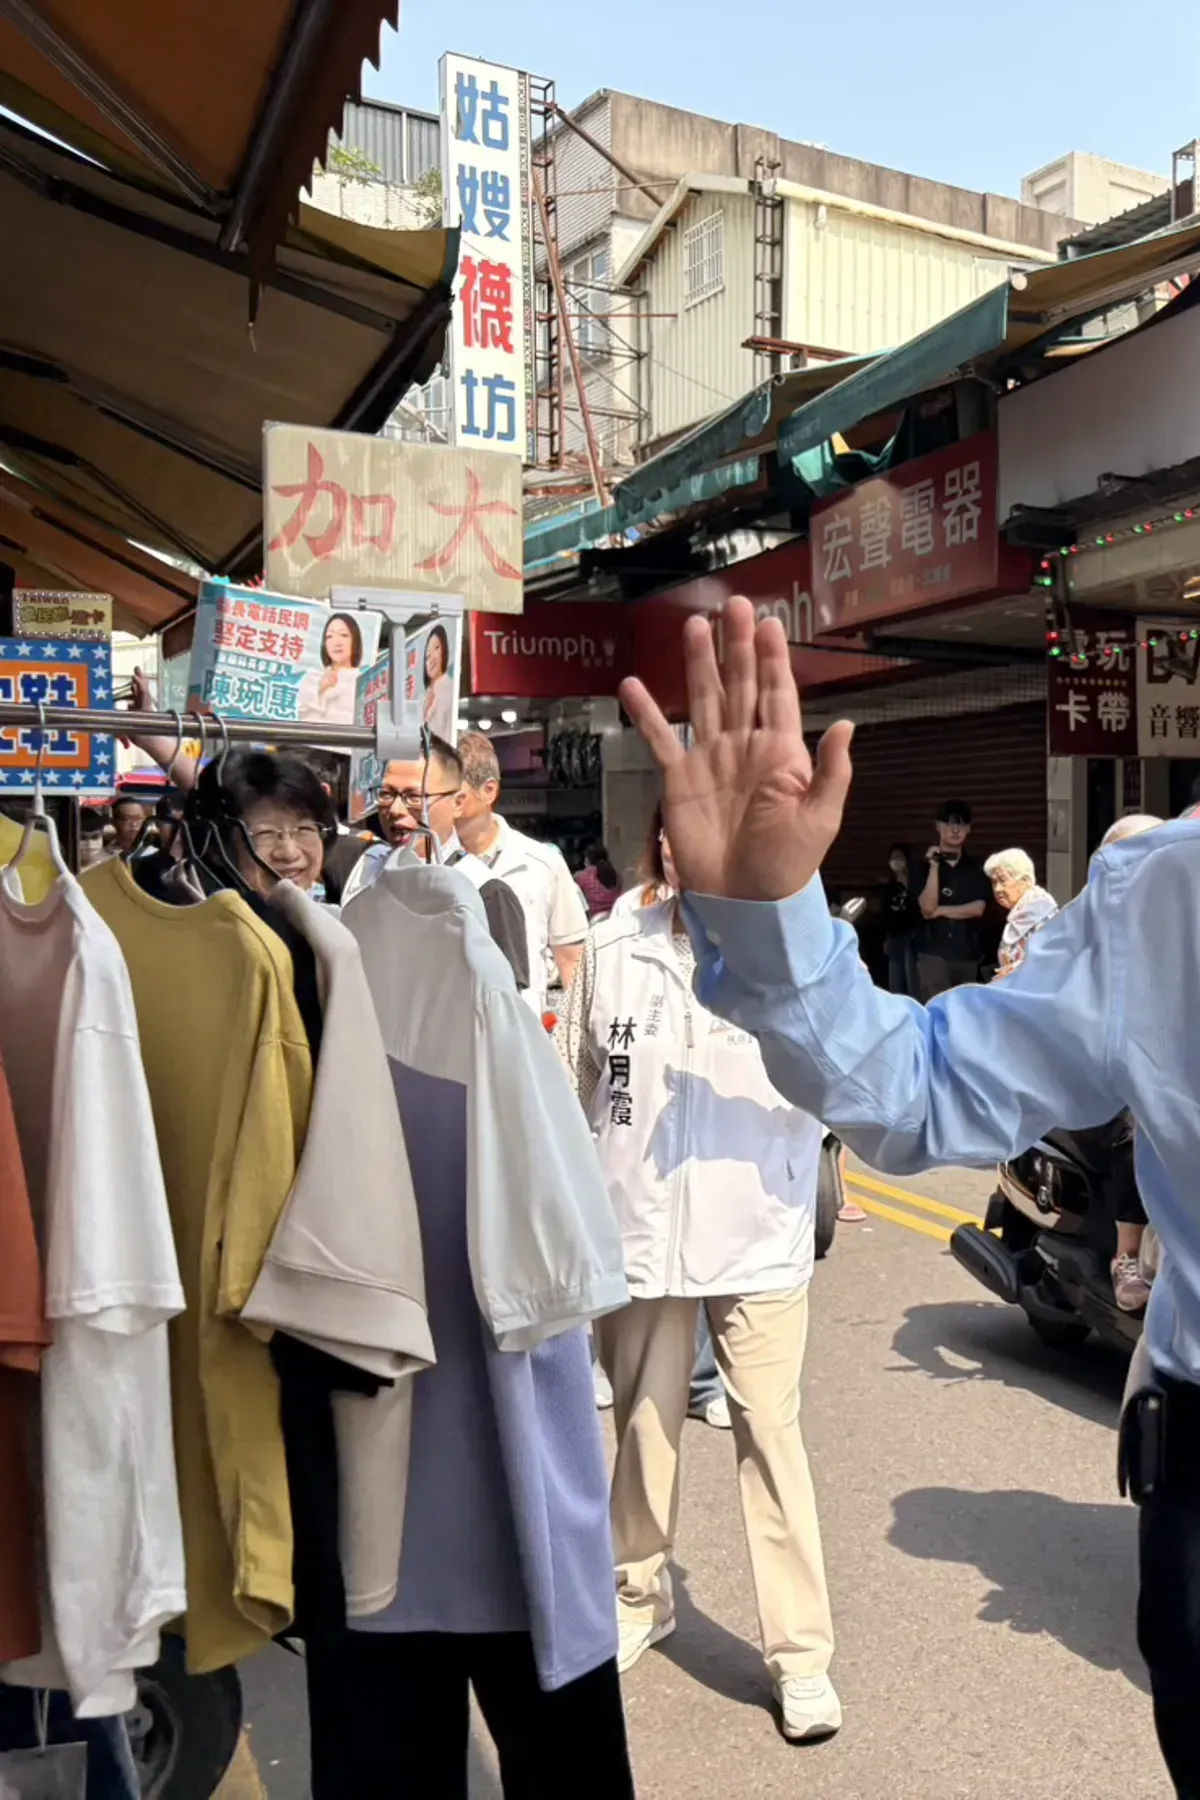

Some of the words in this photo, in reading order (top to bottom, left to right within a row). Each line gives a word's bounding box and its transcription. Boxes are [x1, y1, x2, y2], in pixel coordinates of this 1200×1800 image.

[454, 71, 517, 442] 姑嫂襪坊
[268, 442, 523, 581] 加大
[822, 460, 983, 583] 宏聲電器
[212, 618, 305, 661] 堅定支持
[483, 629, 597, 663] Triumph
[1055, 688, 1132, 734] 卡帶
